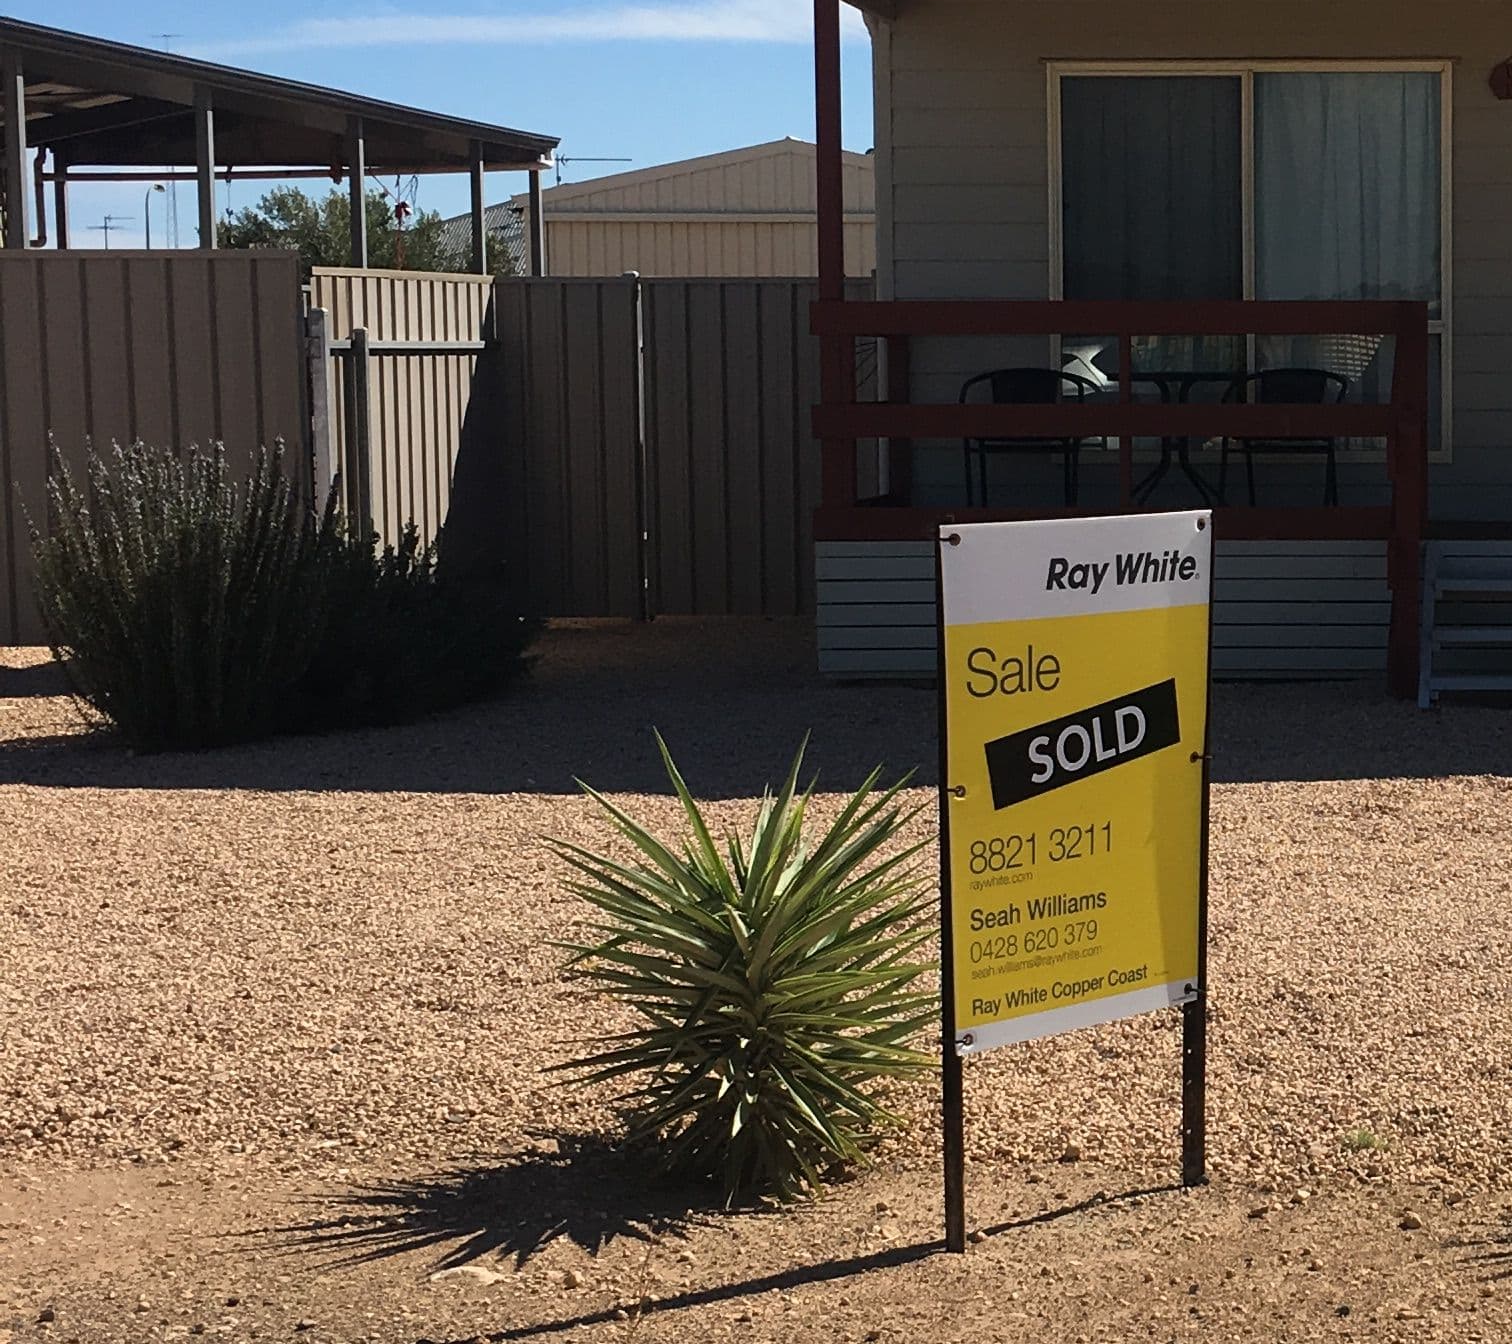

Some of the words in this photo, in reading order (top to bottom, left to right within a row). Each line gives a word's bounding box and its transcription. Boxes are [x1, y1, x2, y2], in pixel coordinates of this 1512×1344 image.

[1046, 557, 1109, 594] Ray
[1115, 551, 1197, 586] White
[966, 644, 1061, 698] Sale
[1028, 705, 1146, 784] SOLD
[969, 833, 1037, 875] 8821
[1049, 821, 1112, 862] 3211
[969, 870, 1033, 891] raywhite.com
[970, 903, 1021, 931] Seah
[1027, 891, 1107, 921] Williams
[970, 934, 1018, 964] 0428
[1024, 926, 1058, 952] 620
[1063, 919, 1098, 946] 379
[972, 997, 1001, 1017] Ray
[1005, 987, 1048, 1010] White
[1052, 974, 1104, 999] Copper
[1108, 964, 1148, 988] Coast
